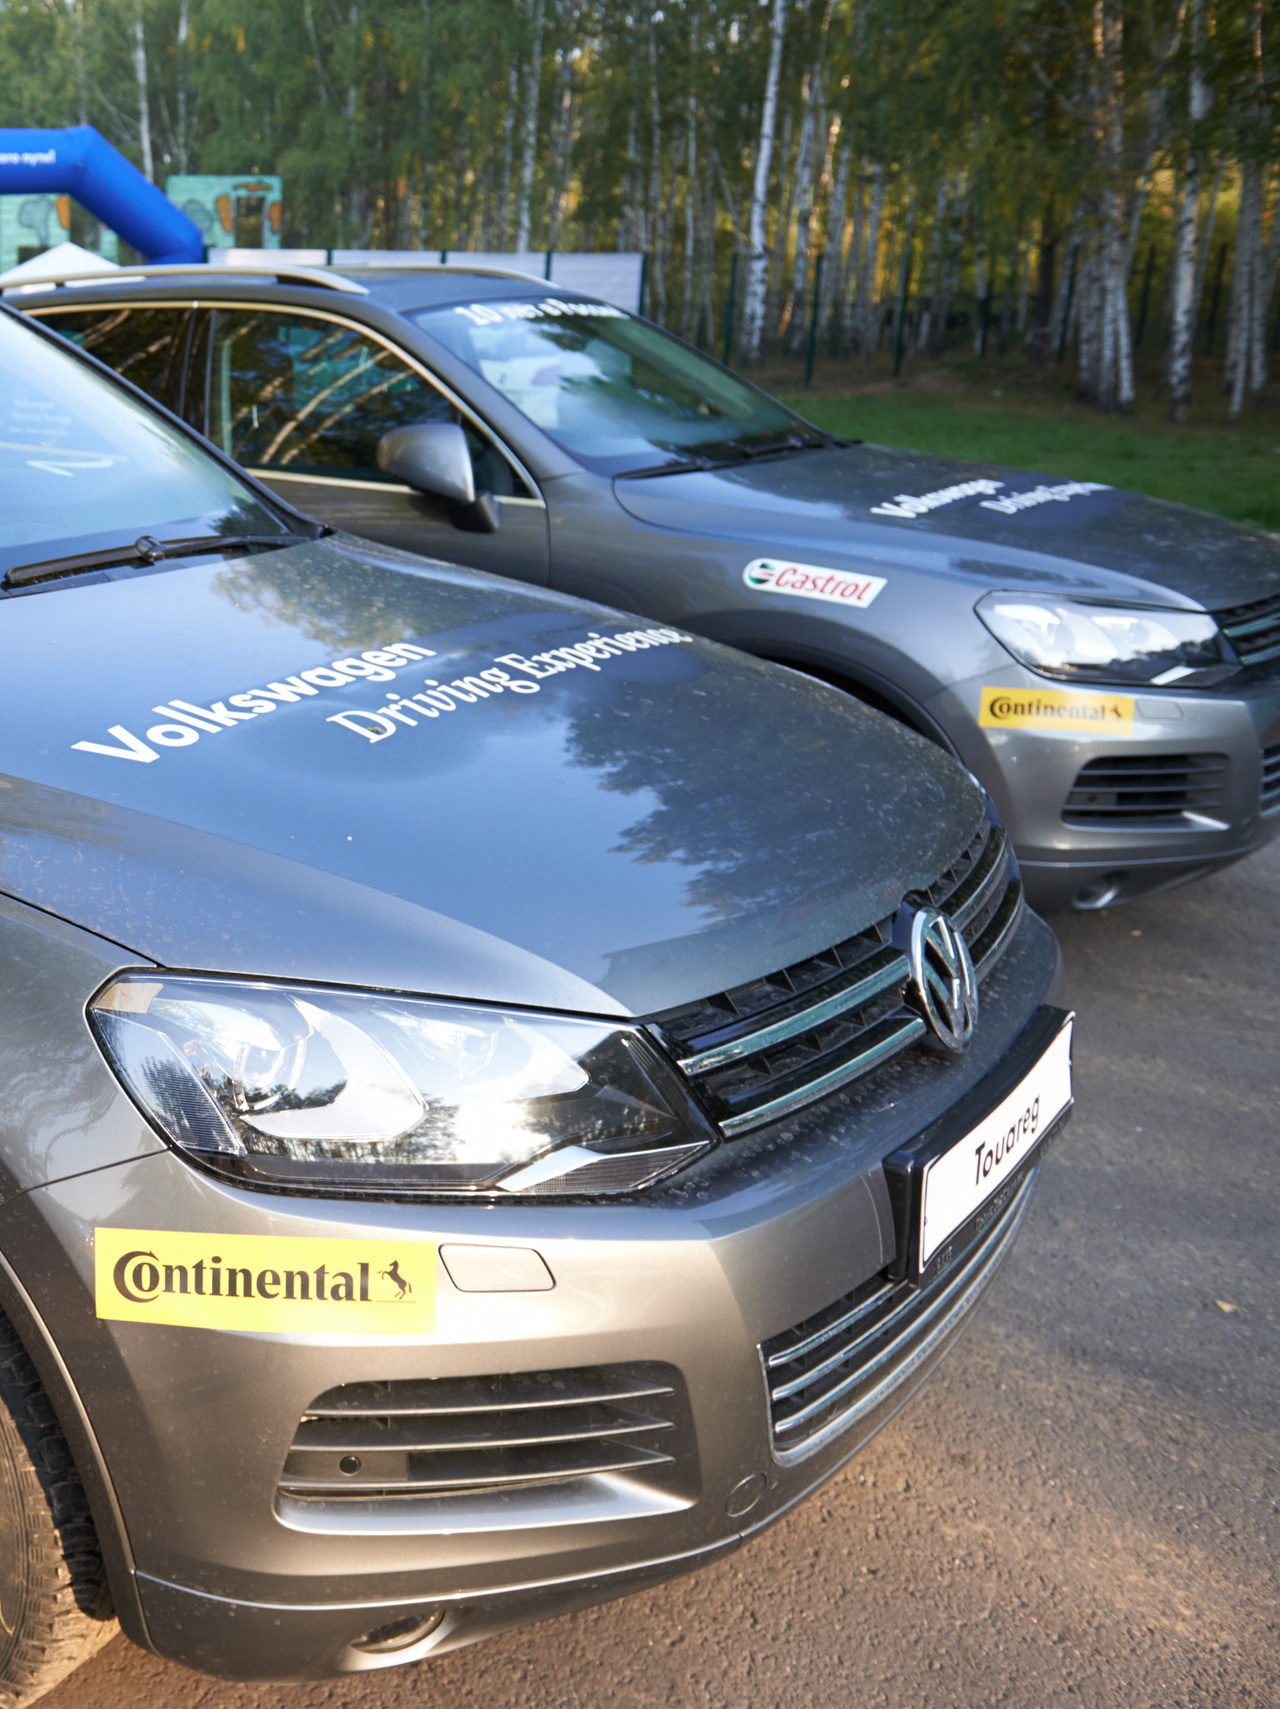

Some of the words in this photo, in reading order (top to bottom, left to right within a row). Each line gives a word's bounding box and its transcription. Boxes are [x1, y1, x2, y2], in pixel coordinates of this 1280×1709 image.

[454, 304, 503, 326] 10
[871, 479, 1005, 518] Volkswagen
[775, 567, 872, 601] Castrol
[70, 641, 436, 764] Volkswagen
[326, 664, 540, 744] Driving
[495, 626, 693, 680] Experience
[989, 696, 1106, 720] Continental
[974, 1094, 1041, 1187] Touareg
[113, 1250, 373, 1303] Continental
